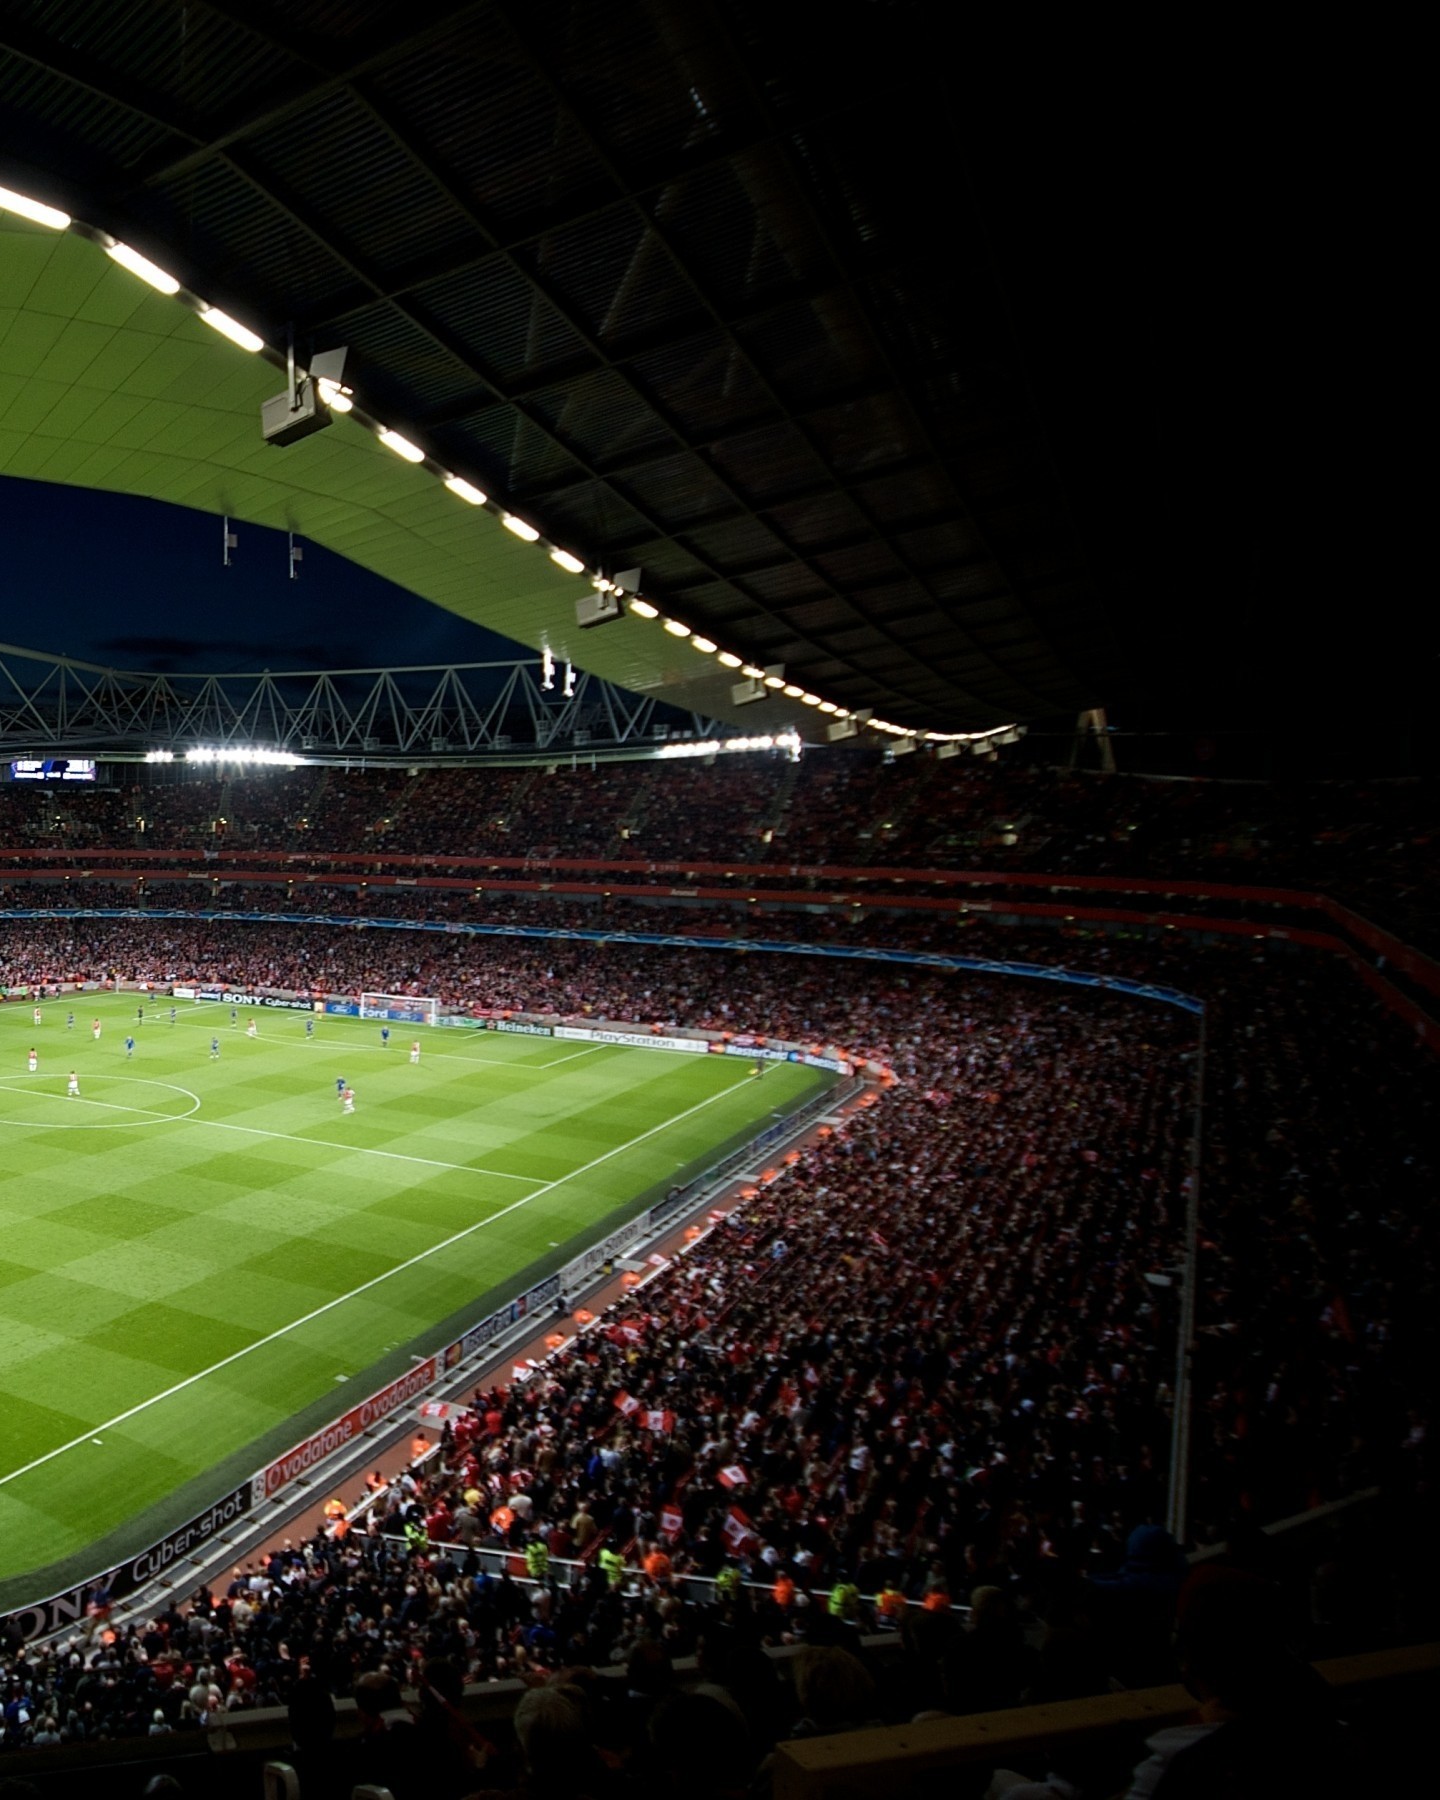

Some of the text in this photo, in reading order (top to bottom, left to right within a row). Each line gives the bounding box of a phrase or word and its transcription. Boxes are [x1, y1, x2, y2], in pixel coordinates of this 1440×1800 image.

[222, 992, 264, 1005] SONY
[265, 997, 312, 1009] Cyber-shot
[360, 1007, 389, 1019] Ford
[496, 1020, 551, 1036] Heineken
[589, 1029, 676, 1050] PlayStation
[726, 1045, 789, 1061] MasterCard
[371, 1367, 432, 1417] vodafone
[281, 1419, 353, 1480] vodafone
[132, 1491, 244, 1583] Cyber-shot
